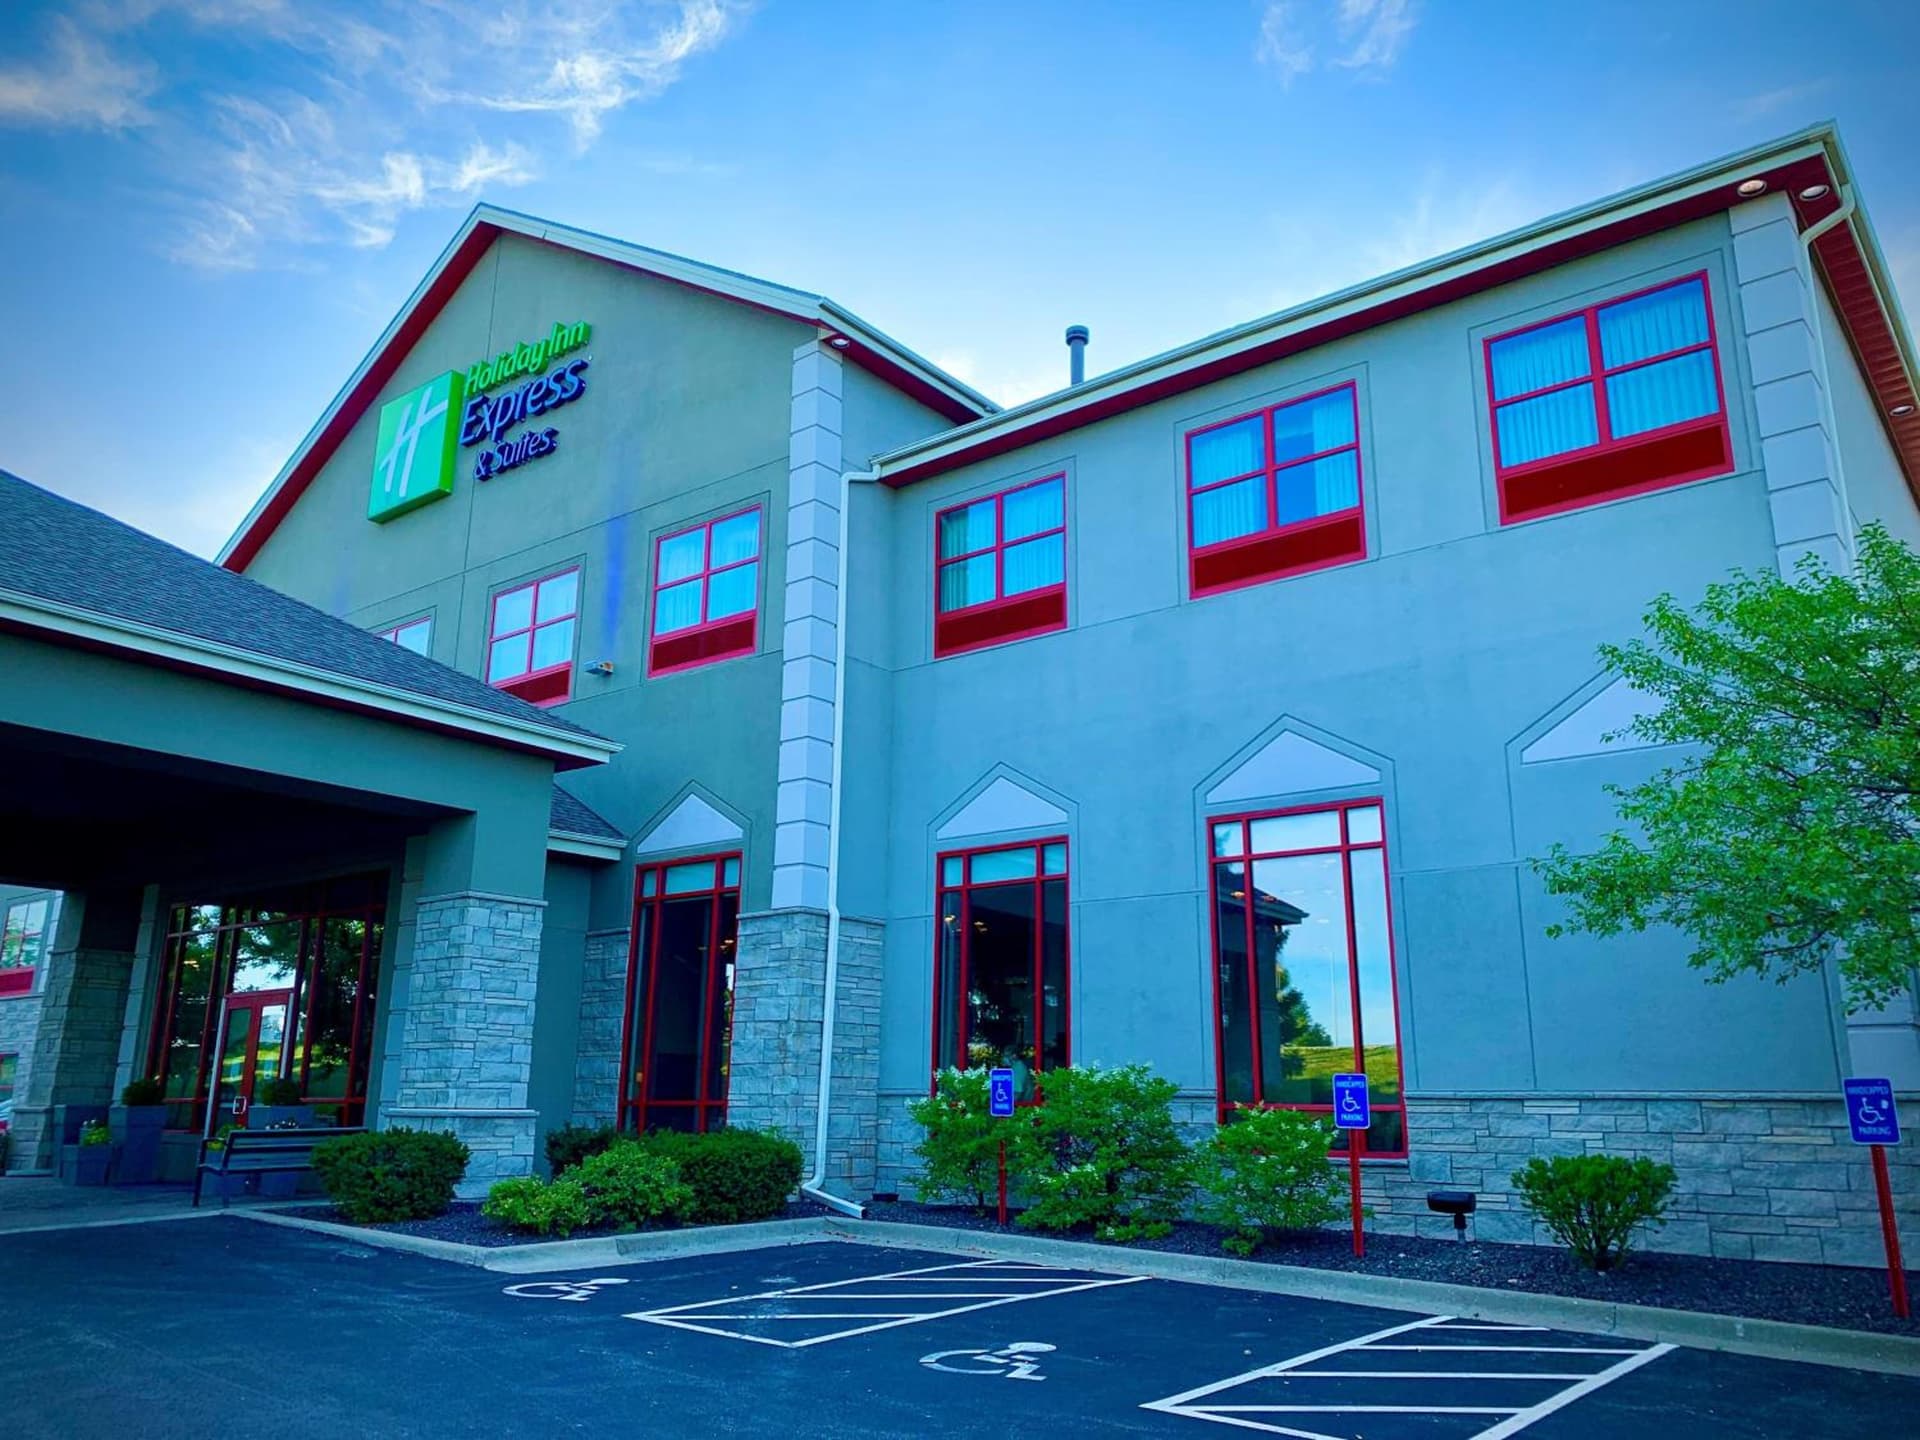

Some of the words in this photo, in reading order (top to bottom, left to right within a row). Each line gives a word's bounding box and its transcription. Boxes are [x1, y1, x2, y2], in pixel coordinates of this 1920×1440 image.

[463, 340, 549, 397] Holiday
[548, 320, 591, 359] Inn
[460, 359, 589, 447] Express
[474, 449, 493, 481] &
[491, 427, 560, 474] Suites
